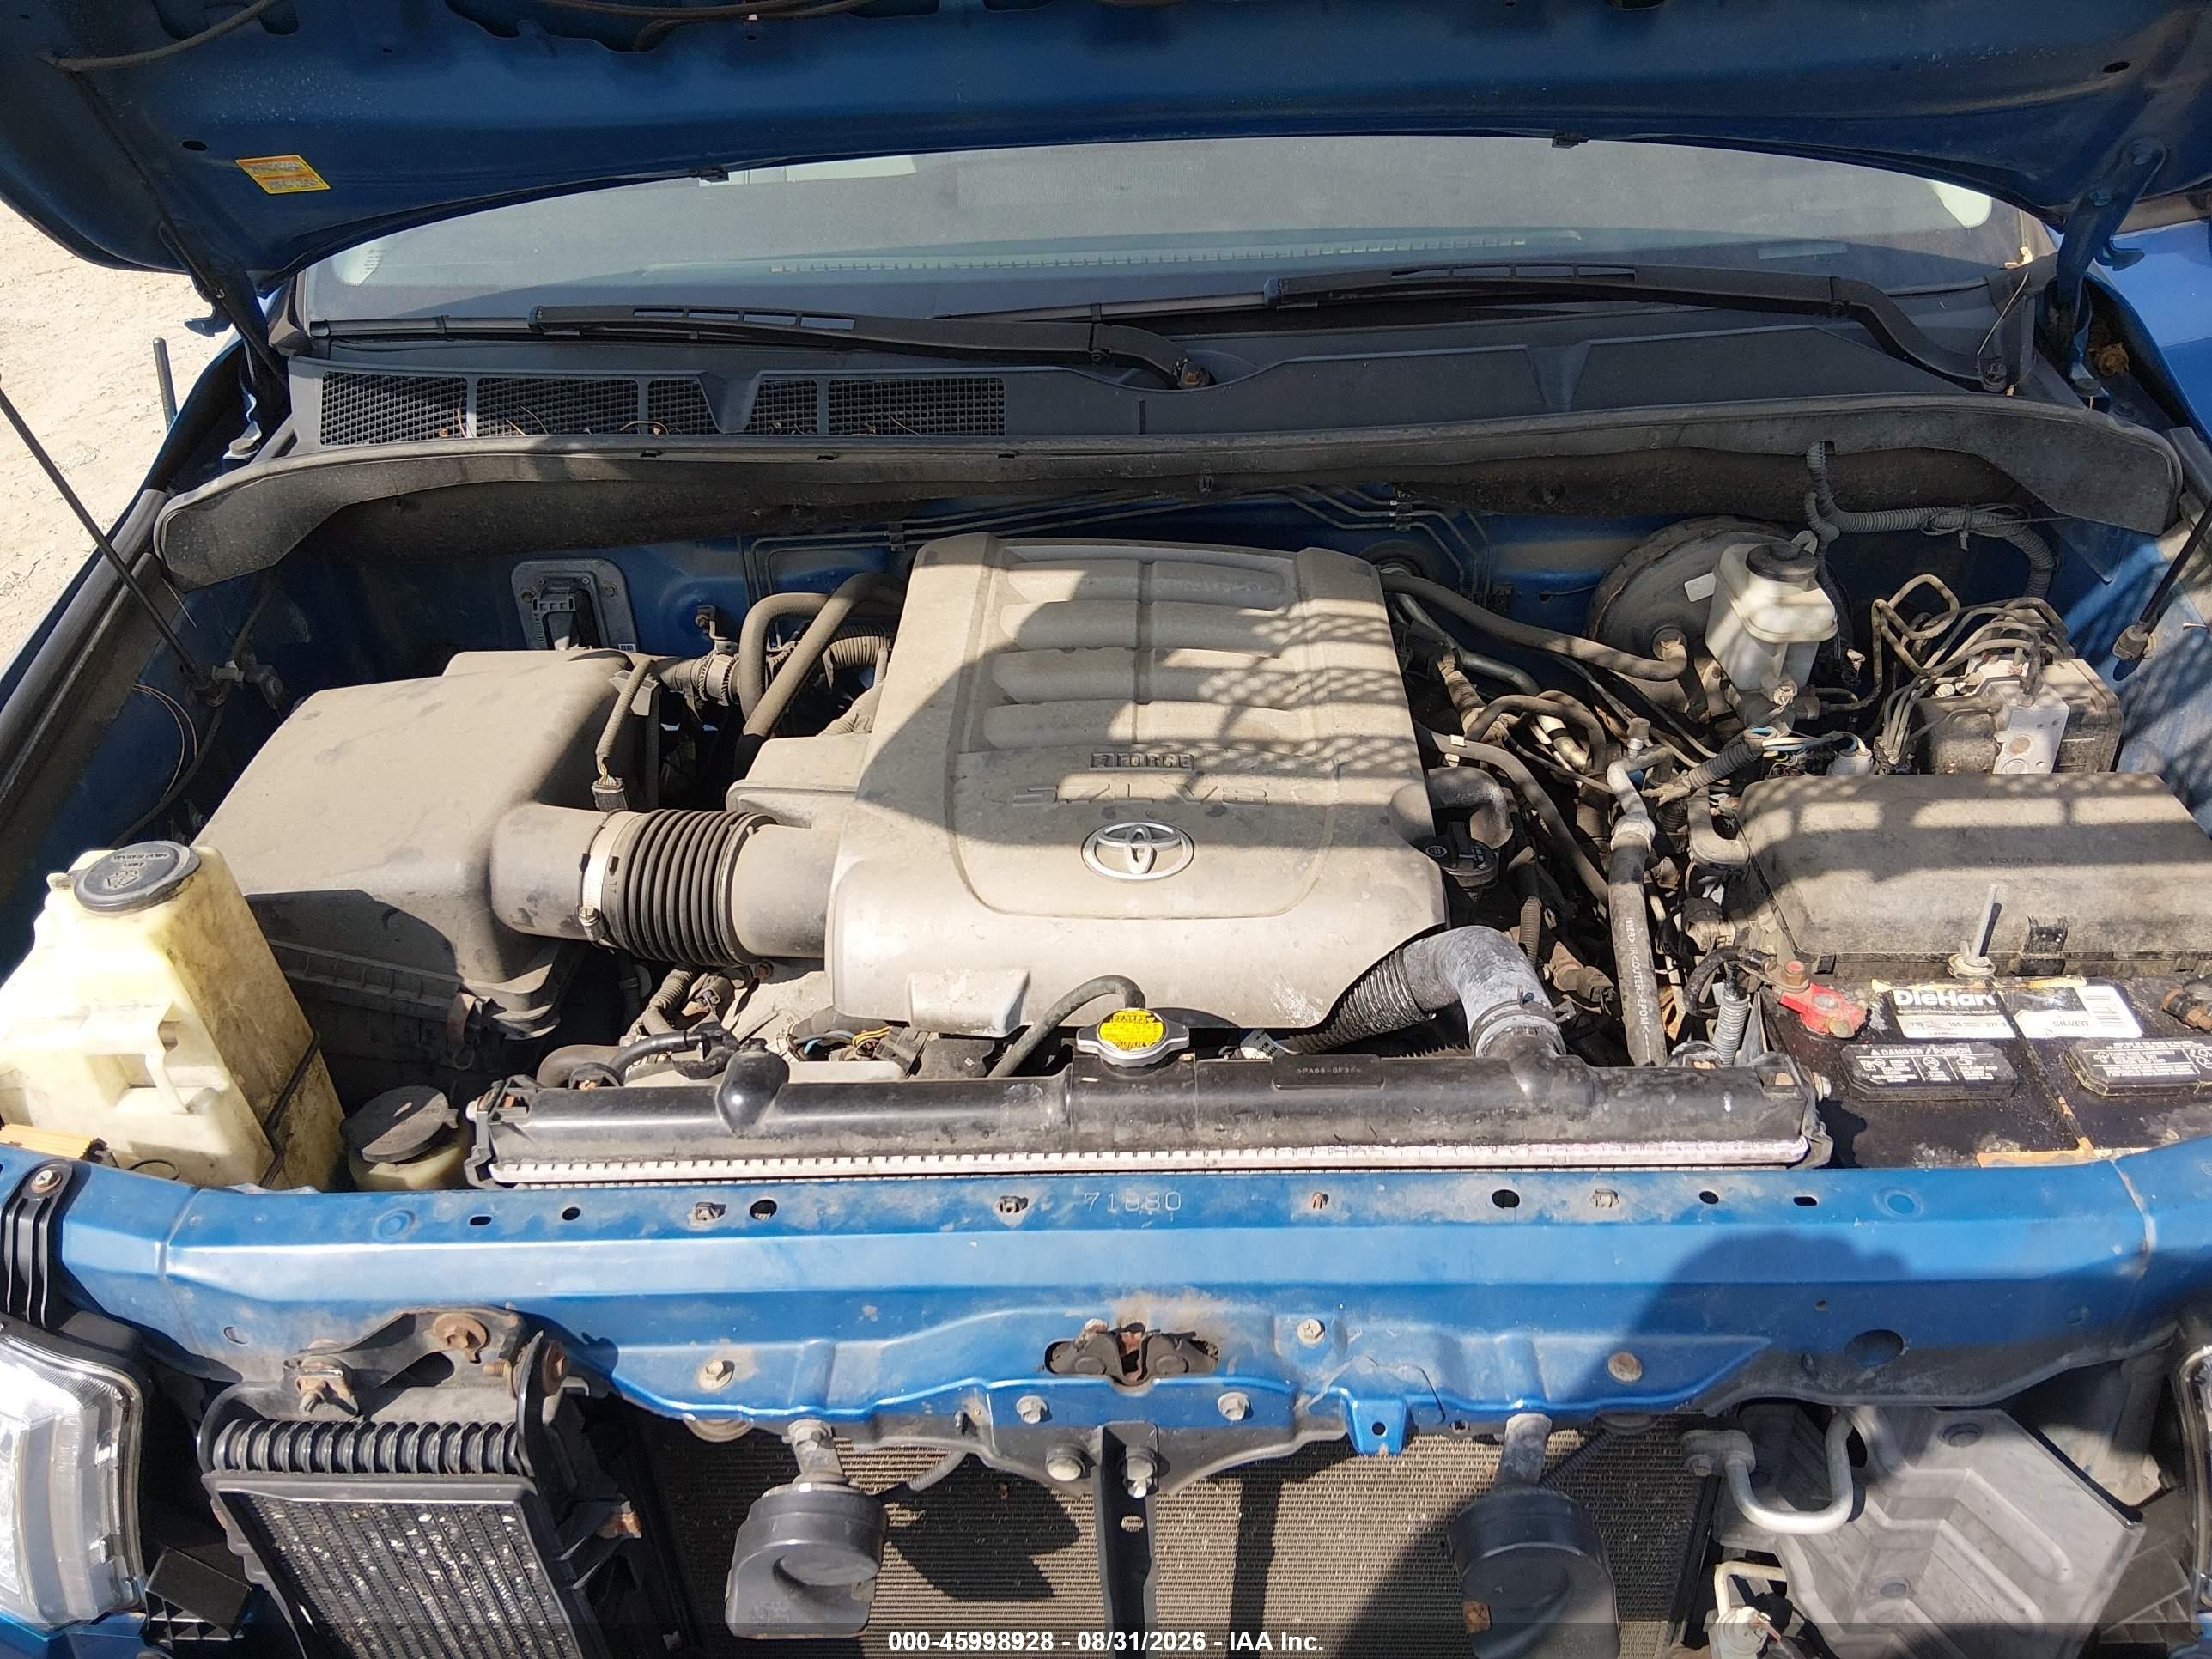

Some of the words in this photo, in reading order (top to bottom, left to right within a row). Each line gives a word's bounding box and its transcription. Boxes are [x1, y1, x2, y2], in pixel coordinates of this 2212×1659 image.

[1116, 752, 1194, 769] FORCE
[1166, 776, 1269, 806] V8
[1881, 1048, 1924, 1056] DANGER
[1934, 1047, 1972, 1055] POISON
